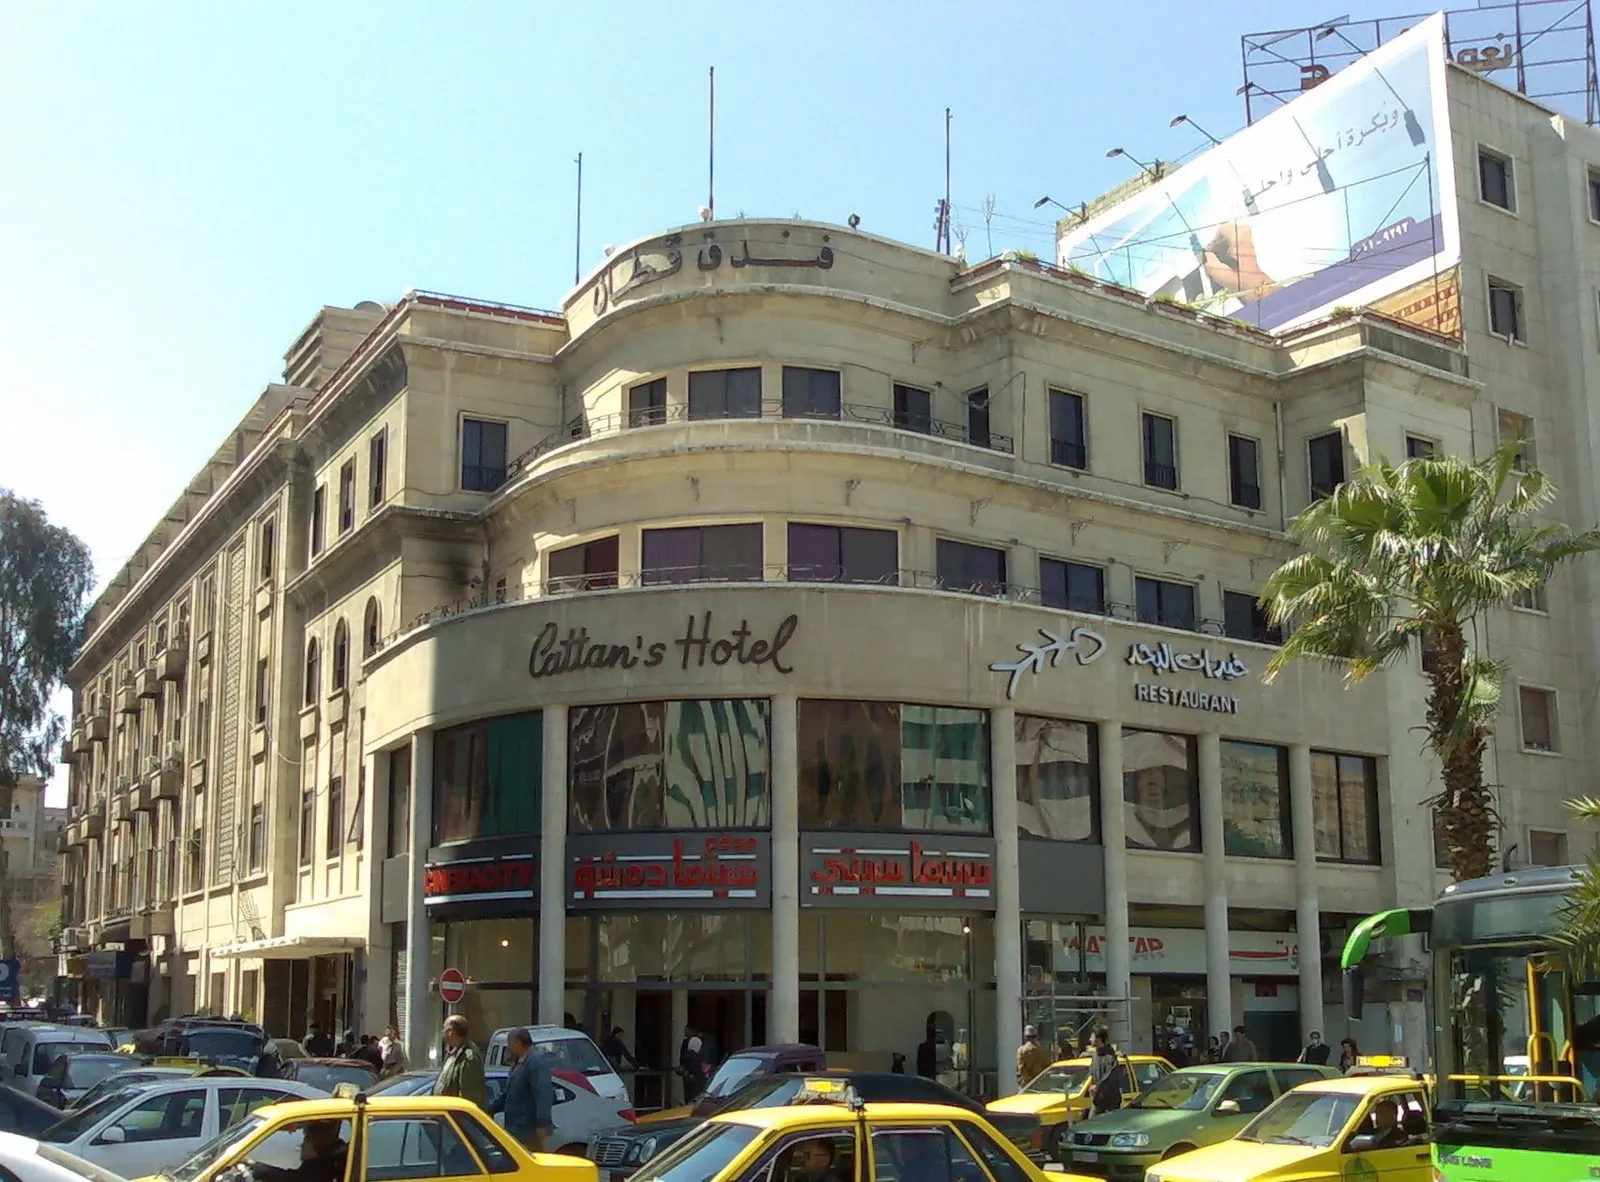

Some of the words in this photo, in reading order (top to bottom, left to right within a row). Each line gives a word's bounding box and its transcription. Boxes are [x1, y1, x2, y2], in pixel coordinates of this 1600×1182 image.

[592, 234, 683, 317] قطان
[697, 231, 834, 271] فندق
[529, 622, 667, 678] Cattan's
[675, 610, 798, 674] Hotel
[1124, 642, 1179, 676] البحر
[1175, 648, 1250, 681] خيرات
[1135, 683, 1240, 714] RESTAURANT
[574, 850, 668, 899] دمشق
[673, 838, 758, 898] سينما
[811, 848, 904, 897] سيتي
[910, 840, 991, 897] سينما
